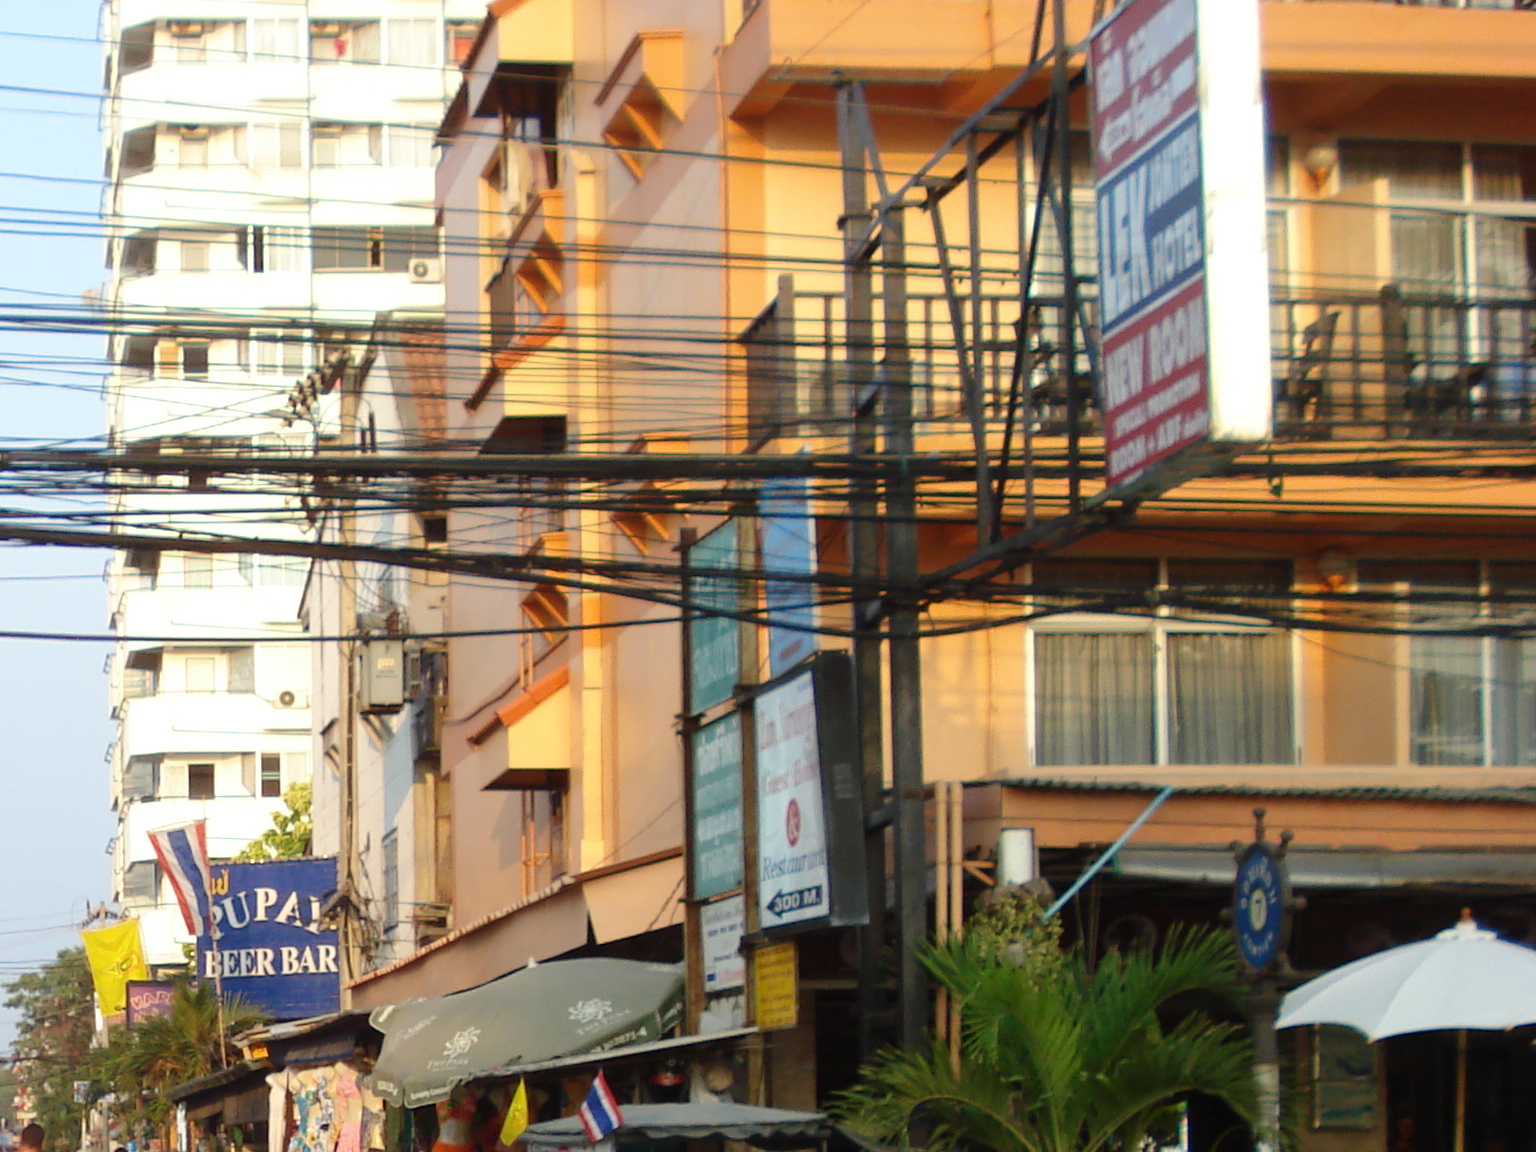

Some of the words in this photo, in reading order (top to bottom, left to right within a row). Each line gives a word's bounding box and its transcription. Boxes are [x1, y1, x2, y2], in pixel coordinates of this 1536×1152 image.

[1100, 162, 1153, 325] LEK
[1150, 205, 1202, 291] HOTEL
[1105, 334, 1145, 412] NEW
[1149, 297, 1205, 385] ROOM
[774, 893, 800, 913] 300
[804, 888, 822, 905] M.
[204, 947, 276, 978] BEER
[279, 944, 339, 975] BAR
